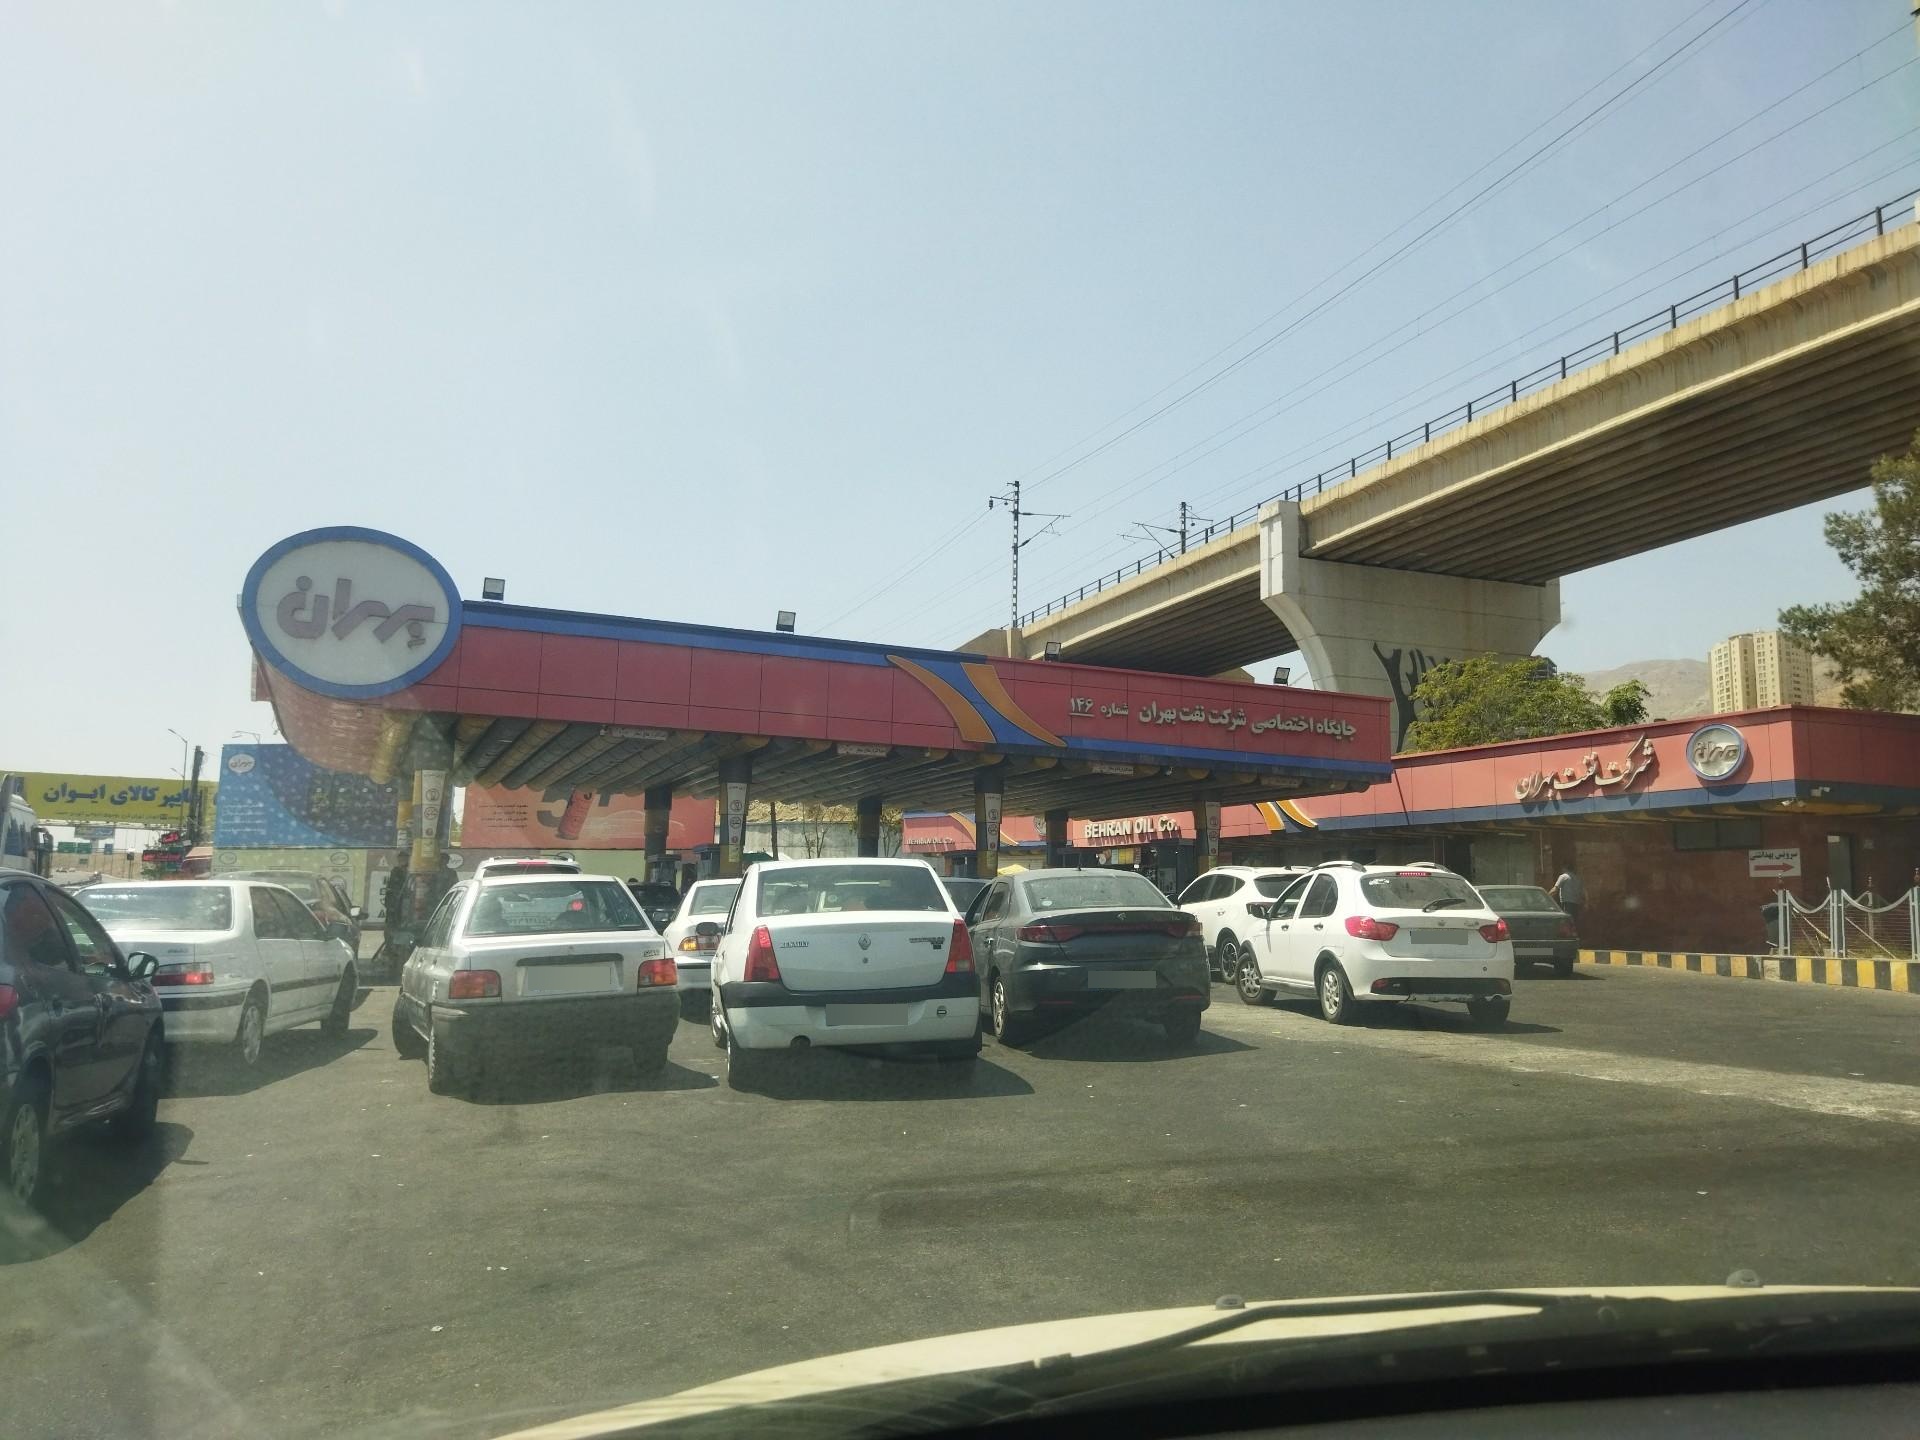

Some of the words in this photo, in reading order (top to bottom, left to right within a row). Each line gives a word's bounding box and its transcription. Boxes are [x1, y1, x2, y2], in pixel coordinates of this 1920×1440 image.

[276, 575, 436, 650] بهران
[1100, 703, 1129, 717] شماره
[1140, 701, 1177, 725] بهران
[1180, 704, 1206, 722] نفت
[1209, 708, 1247, 731] شرکت
[1251, 713, 1314, 735] اختصاصی
[1316, 718, 1357, 741] جایگاه
[1553, 752, 1600, 790] نفت
[1595, 732, 1653, 790] شرکت
[110, 784, 159, 805] کالای
[1515, 770, 1556, 800] بهران
[1084, 818, 1131, 838] BEHRAN
[1134, 817, 1154, 834] OIL
[1158, 815, 1179, 831] Co.
